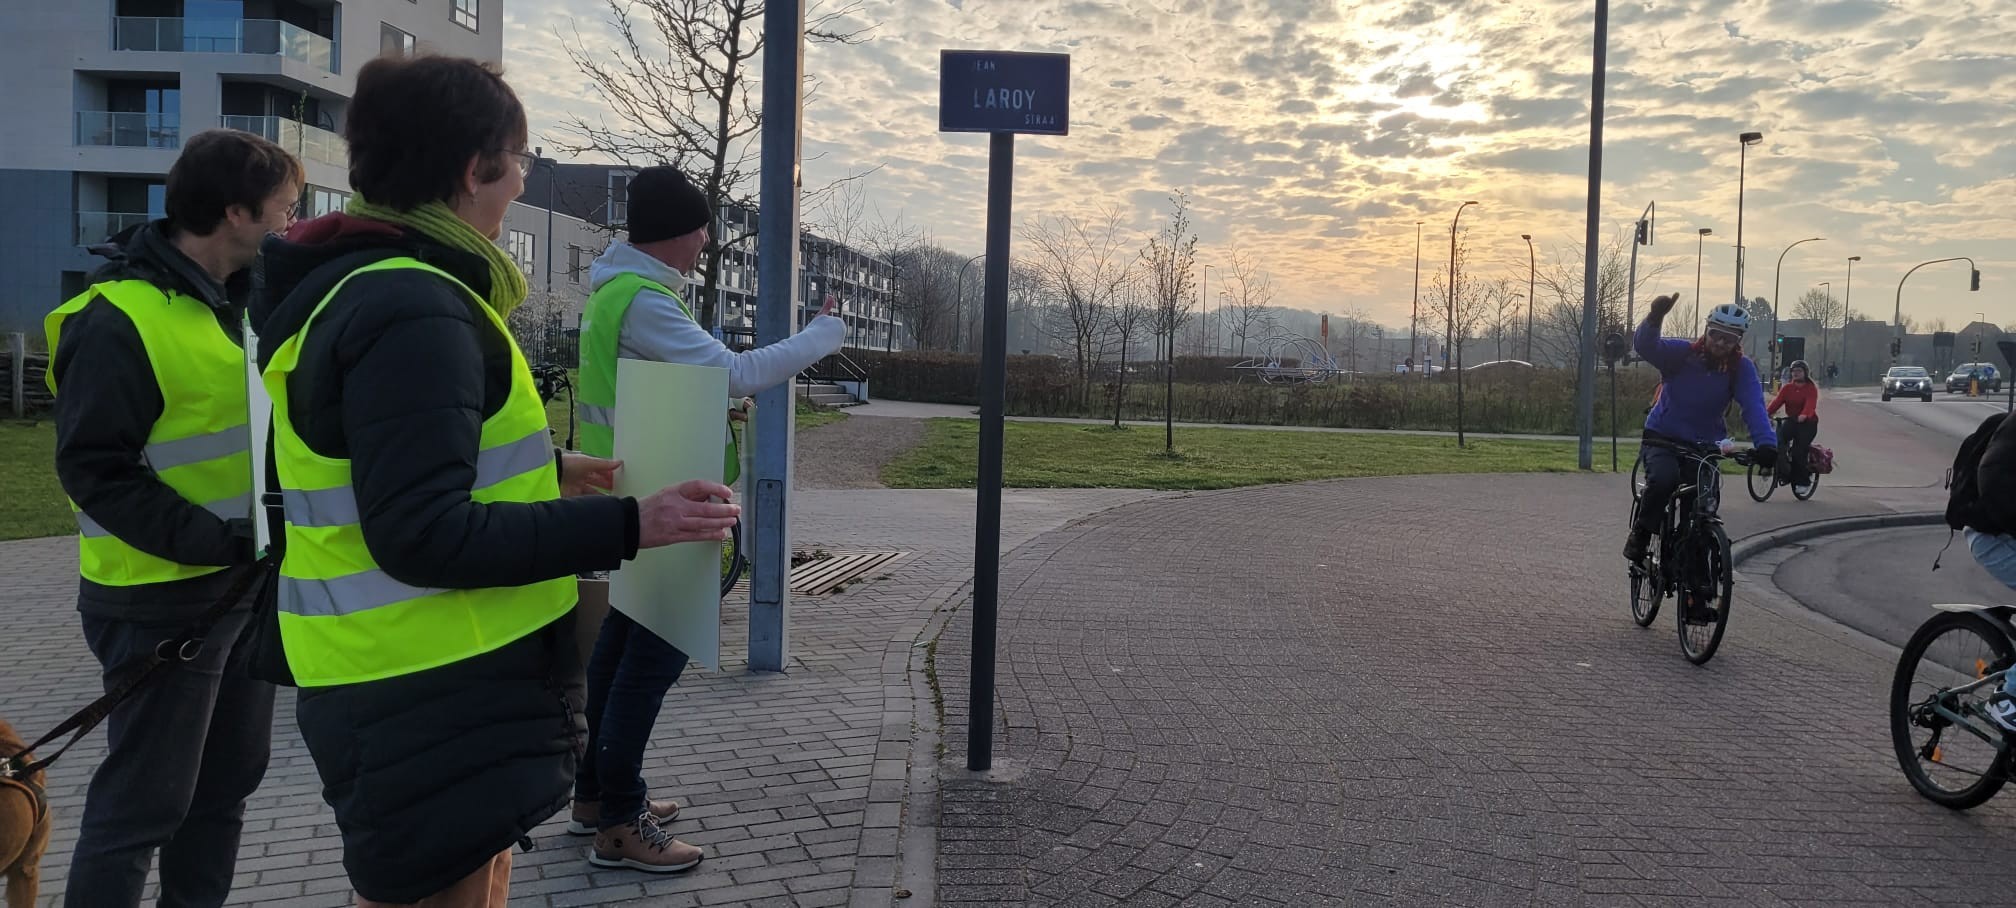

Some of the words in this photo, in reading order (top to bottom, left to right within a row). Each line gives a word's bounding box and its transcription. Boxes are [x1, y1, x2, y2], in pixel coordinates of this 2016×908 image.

[972, 59, 996, 71] EAN
[973, 88, 1036, 110] LAROY
[1024, 113, 1058, 125] STRAA
